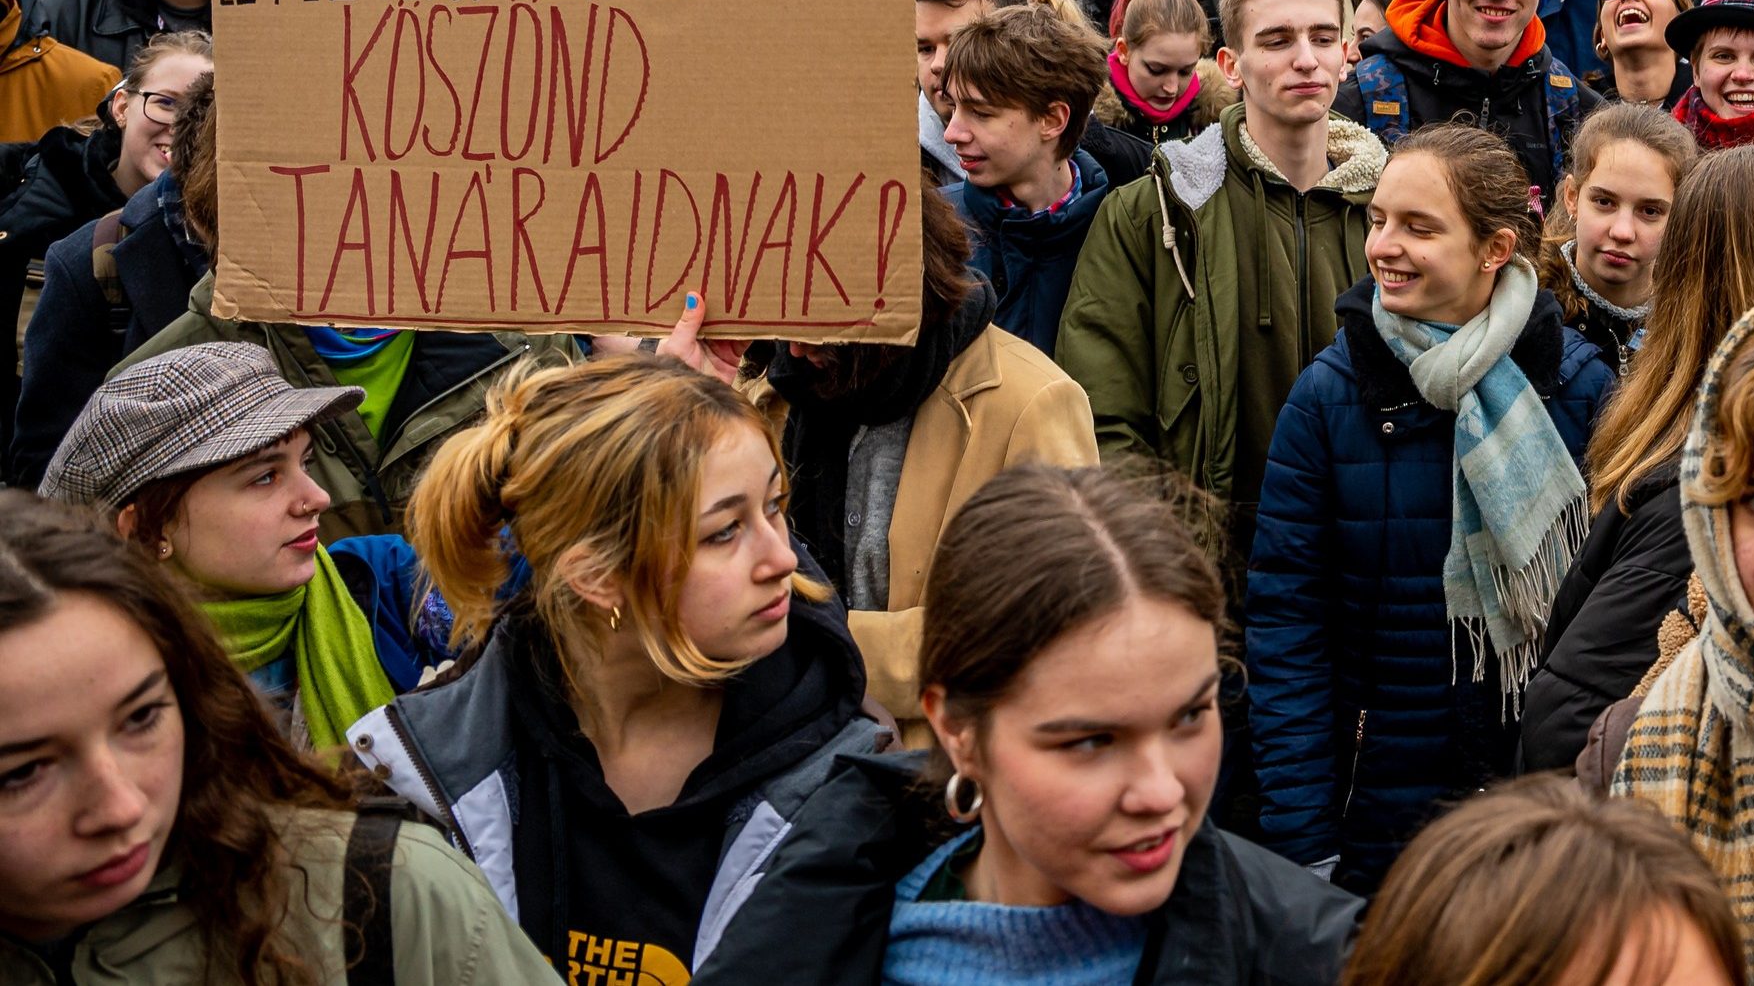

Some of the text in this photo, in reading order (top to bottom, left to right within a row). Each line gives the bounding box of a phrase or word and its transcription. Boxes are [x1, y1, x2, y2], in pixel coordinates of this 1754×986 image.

[269, 163, 909, 320] TANÁRAIDNAK!
[568, 930, 640, 970] THE
[568, 960, 634, 986] RTH
